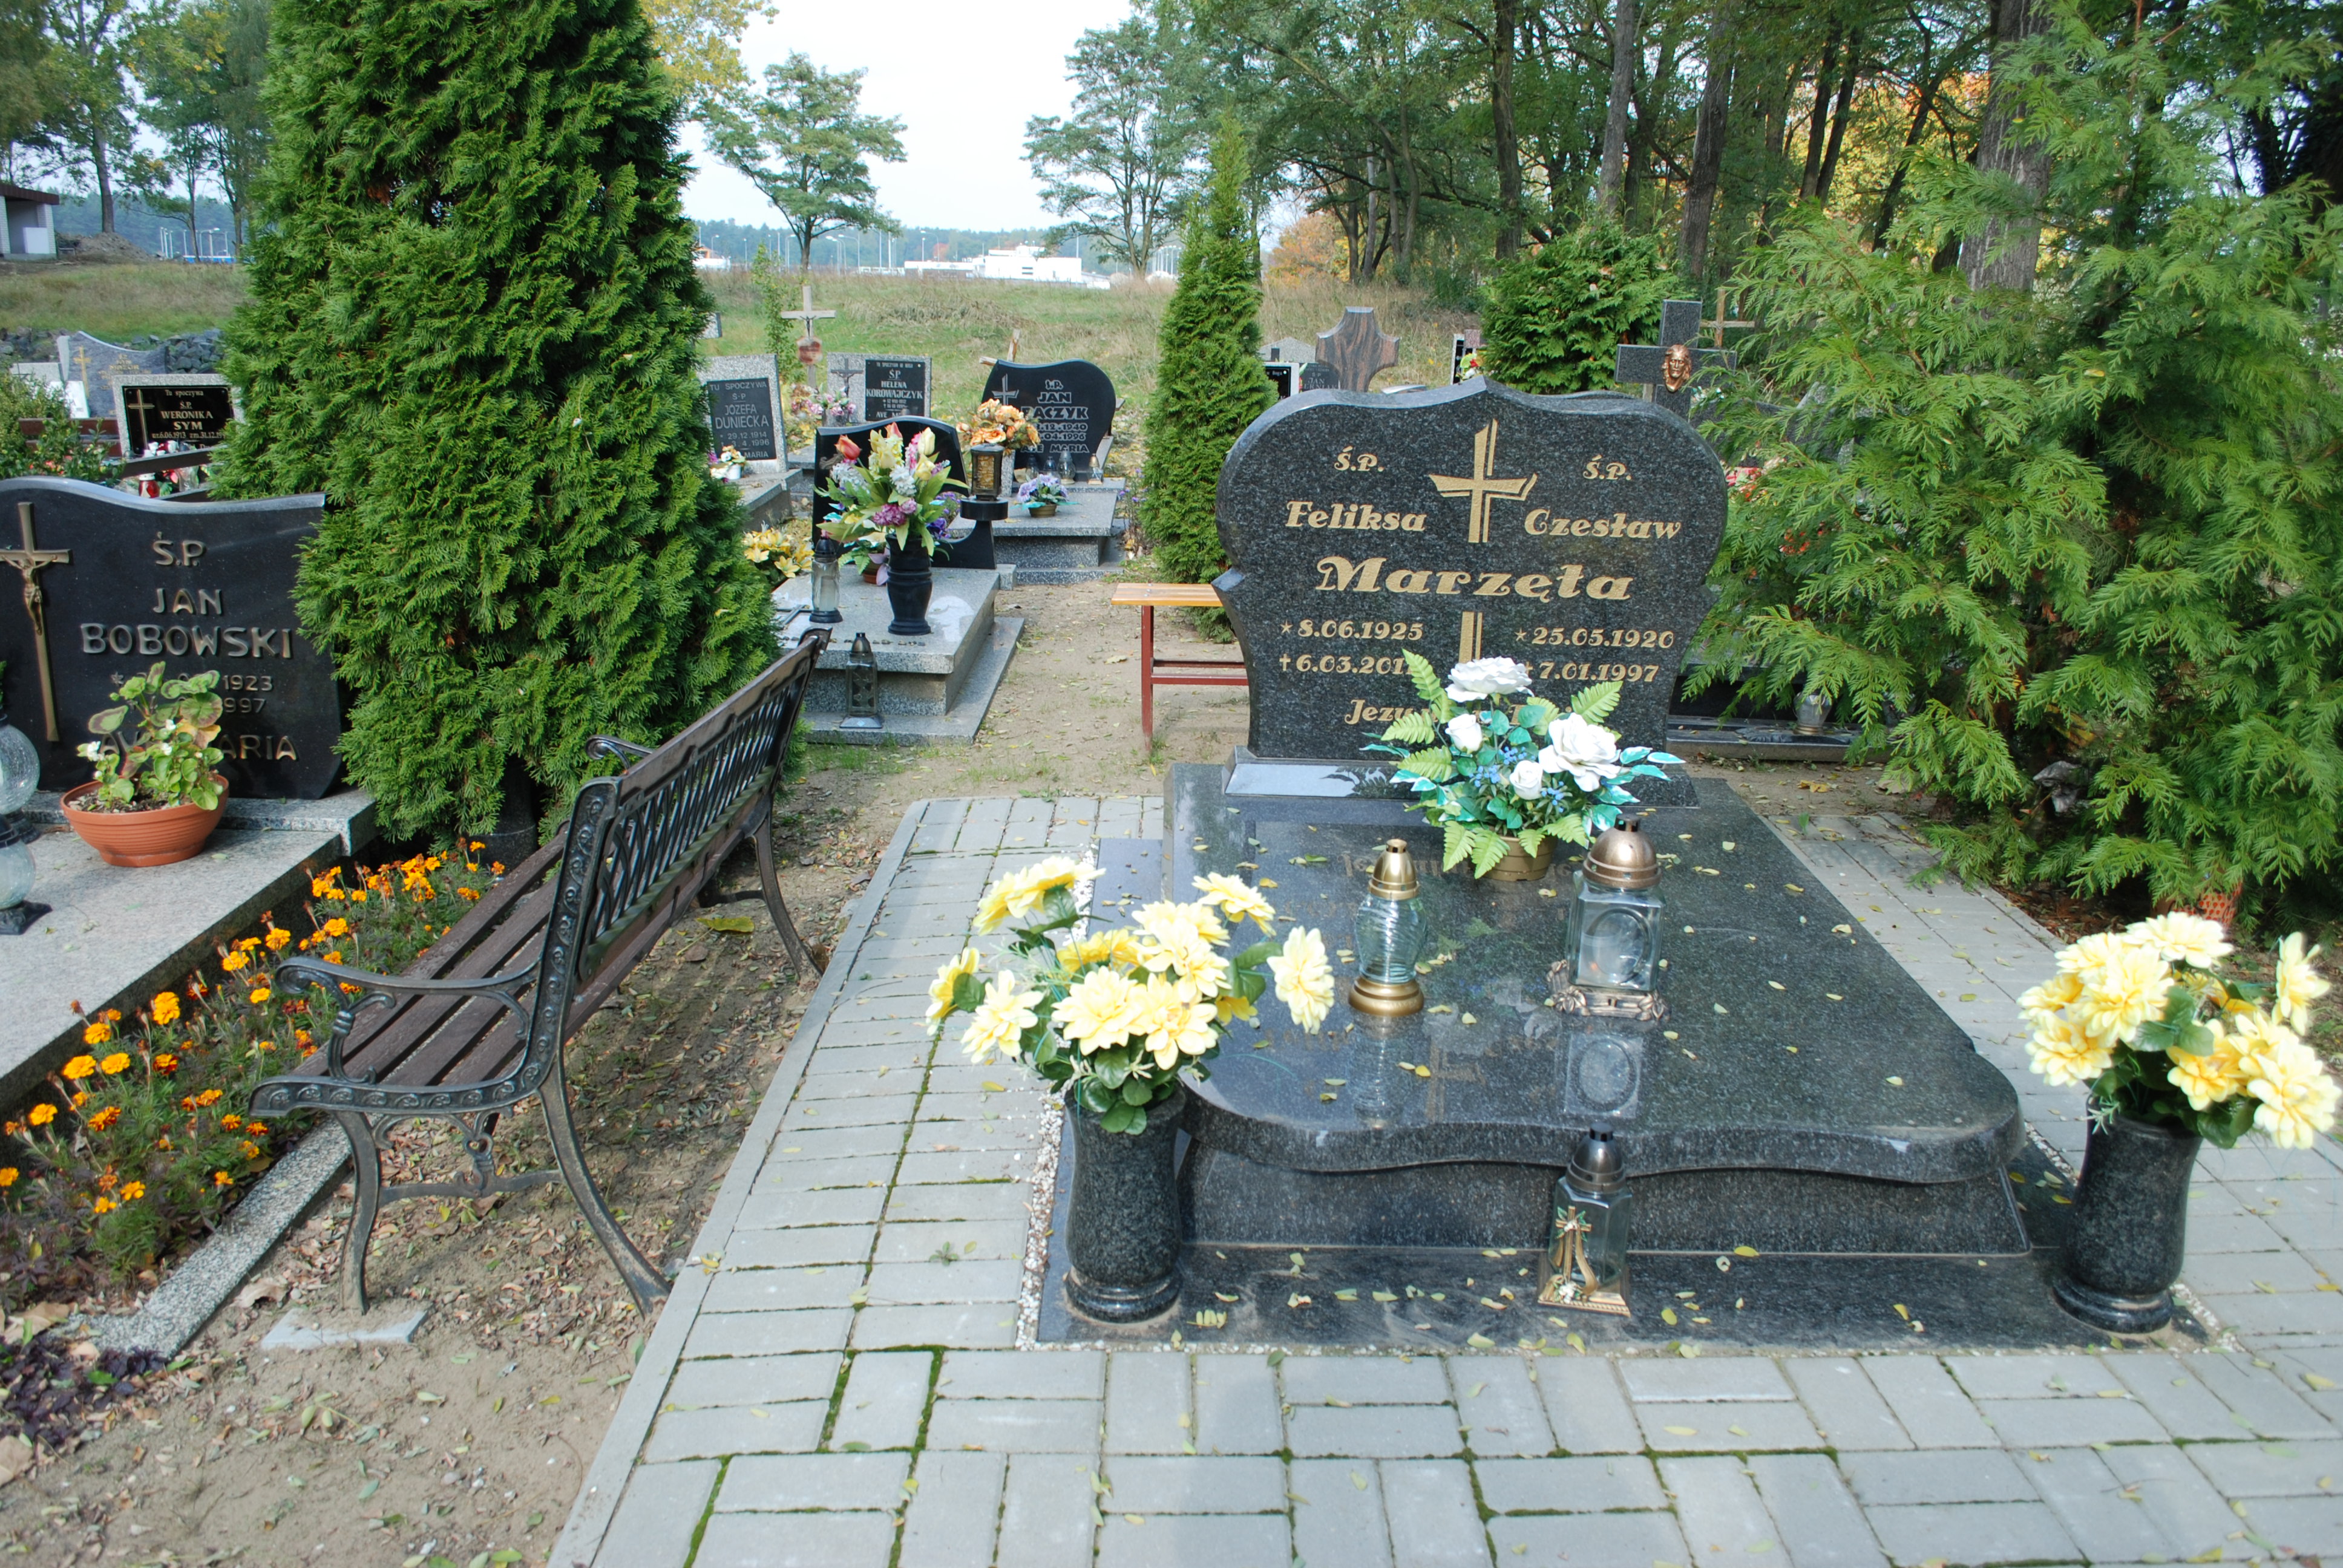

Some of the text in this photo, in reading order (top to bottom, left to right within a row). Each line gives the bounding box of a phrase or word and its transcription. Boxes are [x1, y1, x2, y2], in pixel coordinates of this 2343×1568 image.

[725, 381, 767, 390] SPOCZYWA
[866, 388, 924, 399] KOROWAJCZYK
[881, 381, 907, 389] HELENA
[1037, 392, 1072, 404] JAN
[161, 410, 213, 419] WERONIKA
[715, 414, 770, 429] DUNIECKA
[174, 421, 203, 430] SYM
[1049, 443, 1090, 454] MARIA
[1334, 445, 1384, 472] Ś.P.
[1582, 454, 1632, 481] Ś.P.
[1285, 501, 1427, 531] Feliksa
[1524, 508, 1682, 540] Czesław
[153, 531, 205, 567] Ś.P.
[1316, 556, 1634, 603] Marzęta
[152, 587, 223, 615] JAN
[80, 623, 293, 659] BOBOWSKI
[1532, 627, 1675, 648] 25.05.1920
[1296, 654, 1414, 675] 6.03.201
[1539, 661, 1660, 682] 7.01.1997
[218, 734, 299, 761] ARIA
